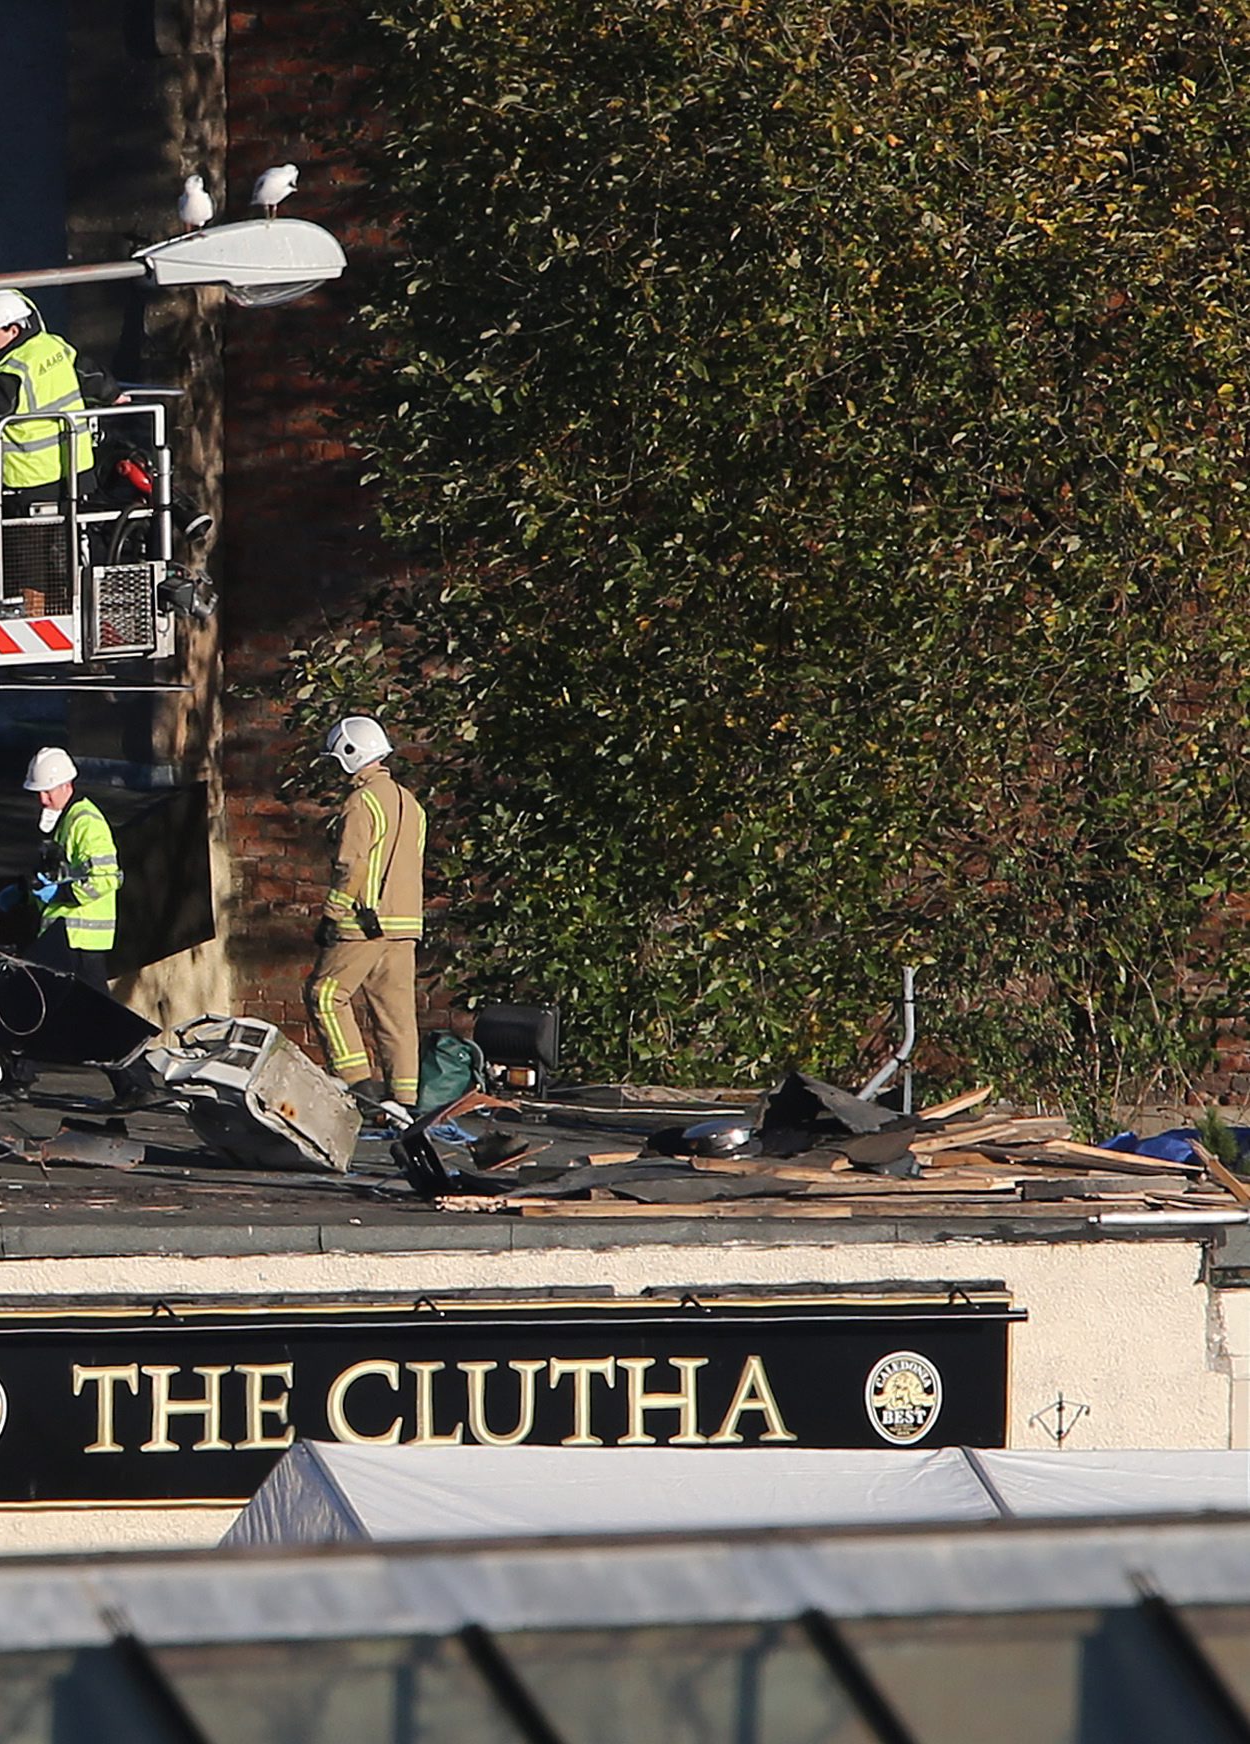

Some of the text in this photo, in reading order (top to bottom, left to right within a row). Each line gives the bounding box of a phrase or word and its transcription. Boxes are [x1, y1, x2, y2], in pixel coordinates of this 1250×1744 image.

[876, 1361, 932, 1388] CALEDONIA
[73, 1354, 798, 1452] THE CLUTHA
[882, 1410, 927, 1424] BEST
